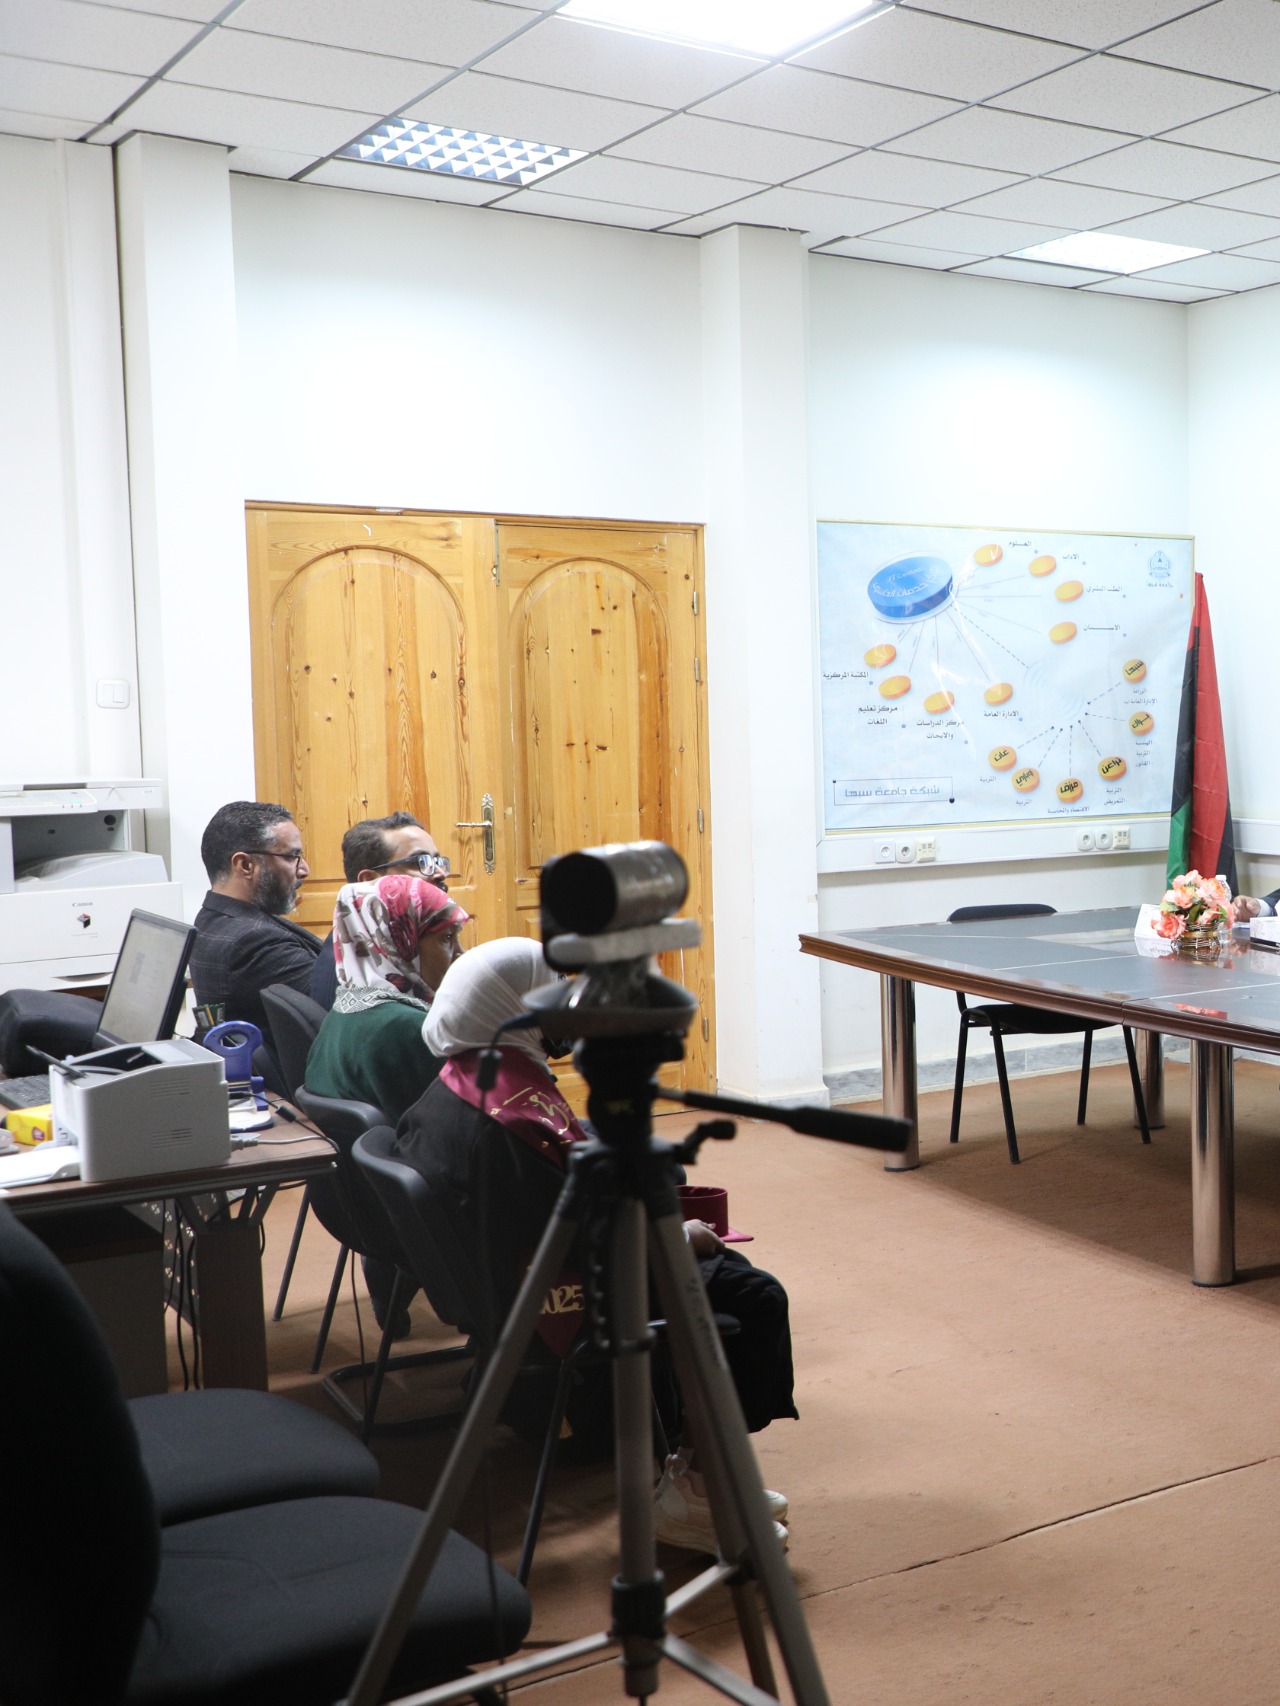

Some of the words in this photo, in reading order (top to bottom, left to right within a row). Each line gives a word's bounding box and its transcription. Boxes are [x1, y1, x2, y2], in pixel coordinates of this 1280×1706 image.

[822, 672, 849, 680] المركزية
[850, 671, 869, 679] المكتبة
[858, 704, 876, 714] تعليم
[877, 704, 898, 713] مركز
[916, 719, 943, 728] الدراسات
[844, 788, 872, 799] سبها
[874, 786, 907, 798] جامعة
[909, 784, 940, 797] شبكة
[540, 1284, 586, 1314] 025
